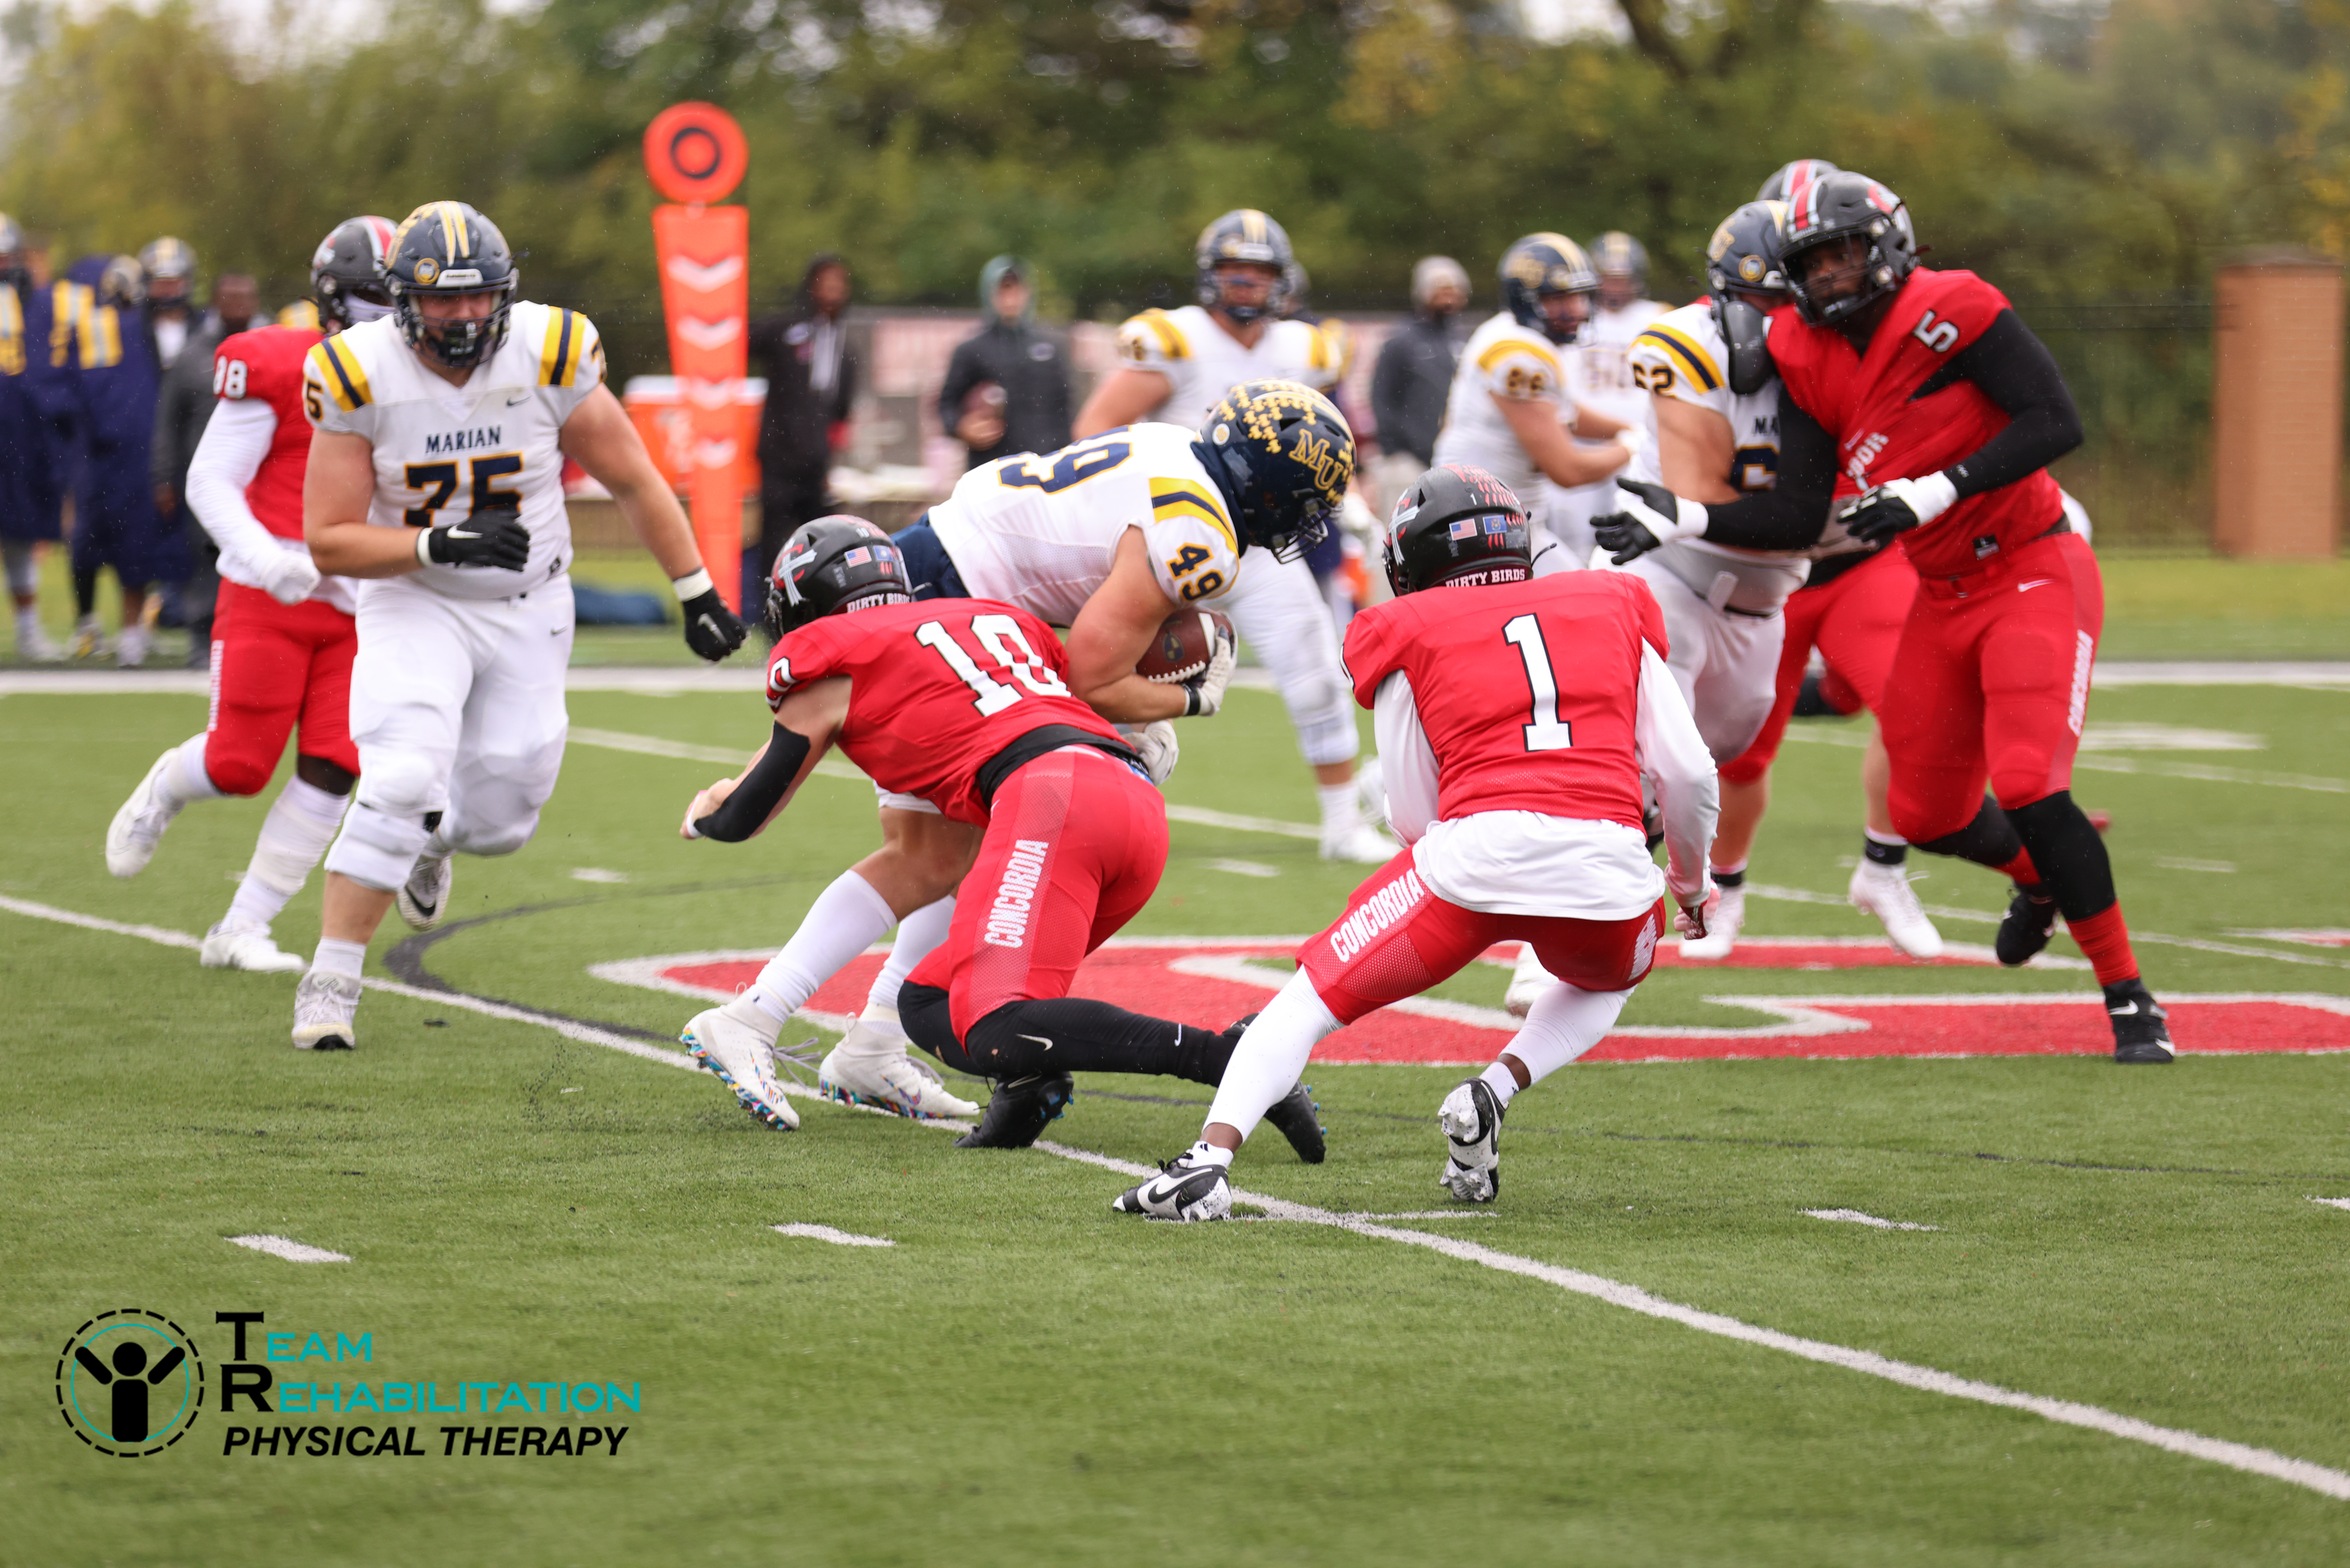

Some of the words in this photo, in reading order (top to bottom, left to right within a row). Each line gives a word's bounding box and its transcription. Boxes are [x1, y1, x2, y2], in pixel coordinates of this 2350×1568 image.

[1912, 308, 1960, 353] 5
[304, 375, 325, 423] 5
[425, 425, 502, 454] MARIAN
[1288, 428, 1344, 490] MU
[403, 450, 524, 528] 75
[1165, 542, 1226, 602] 49
[1445, 571, 1488, 588] DIRTY
[1491, 568, 1526, 583] BIRDS
[846, 594, 885, 614] DIRTY
[913, 614, 1073, 718] 10
[1501, 612, 1573, 752] 1
[983, 839, 1050, 949] CONCORDIA
[1329, 867, 1425, 963] CONCORDIA
